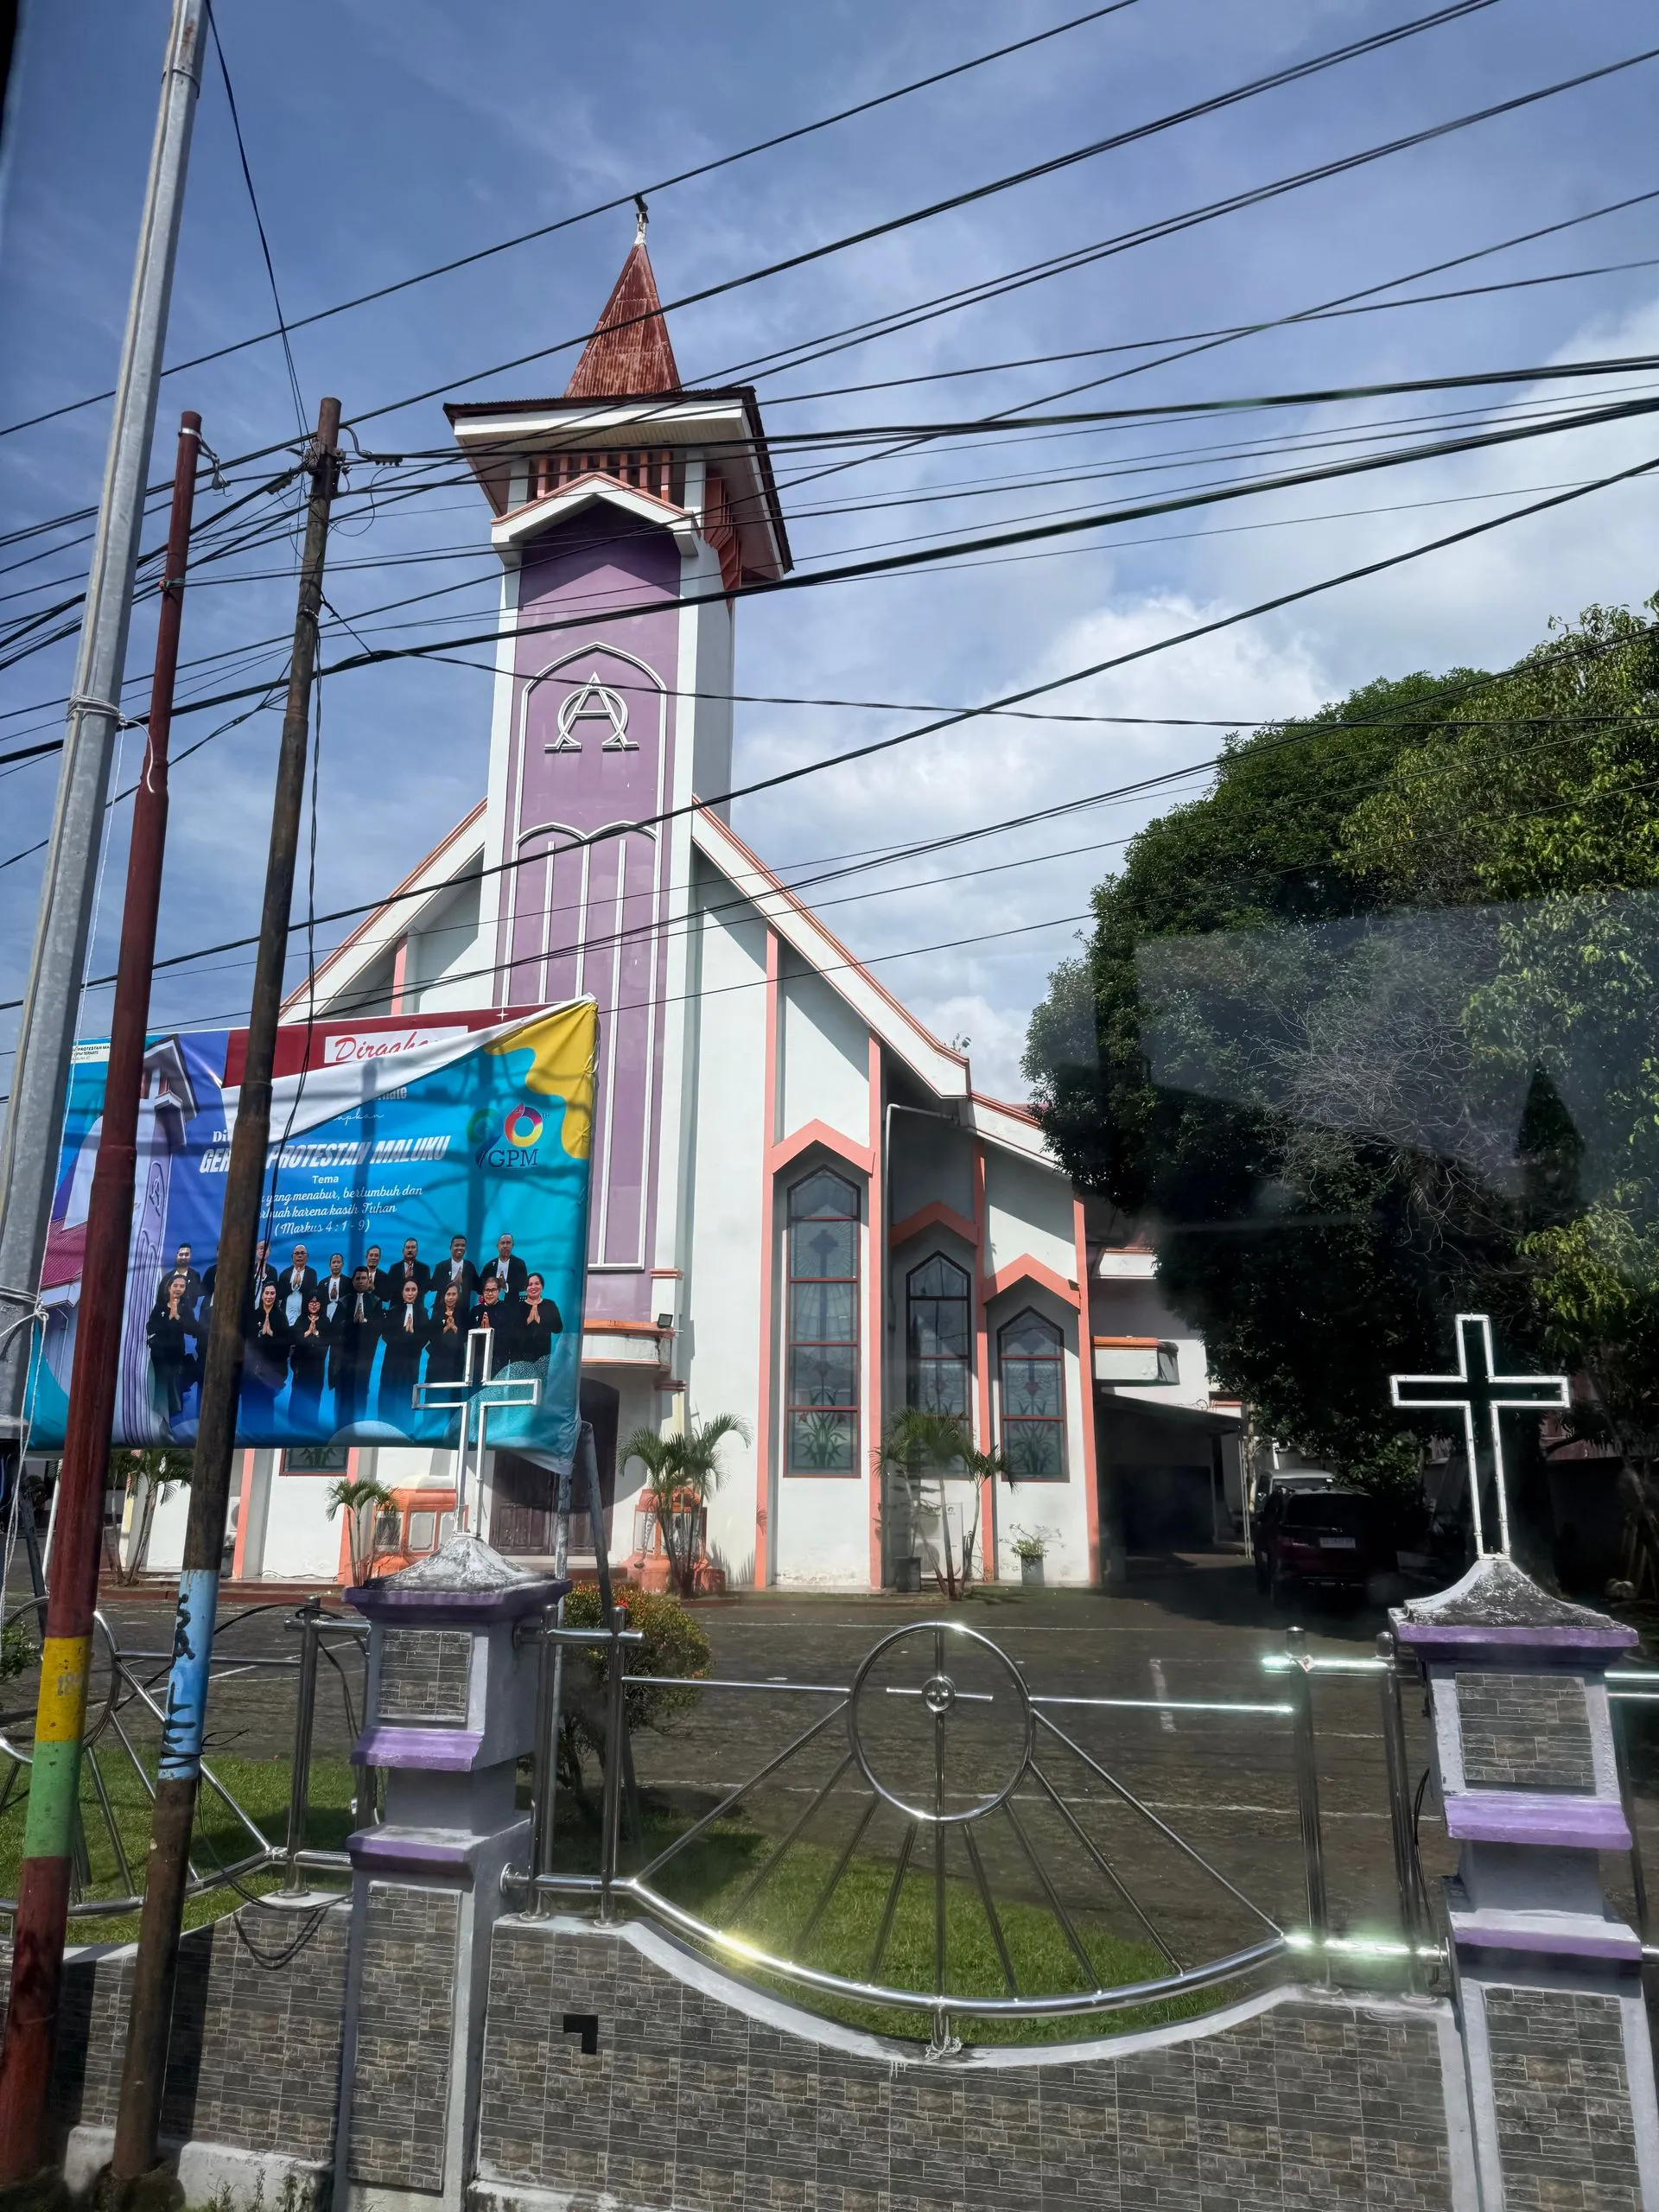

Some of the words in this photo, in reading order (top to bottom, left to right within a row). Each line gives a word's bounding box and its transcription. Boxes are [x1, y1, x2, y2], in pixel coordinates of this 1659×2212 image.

[264, 1141, 372, 1169] PROTESTAN
[369, 1135, 451, 1165] MALUKU
[486, 1148, 538, 1168] GPM
[312, 1175, 340, 1184] Tema
[292, 1189, 340, 1202] menabur,
[402, 1184, 423, 1196] dan
[291, 1206, 329, 1217] karena
[329, 1204, 359, 1216] kasih
[361, 1202, 397, 1214] Tuhan
[325, 1221, 333, 1232] 4
